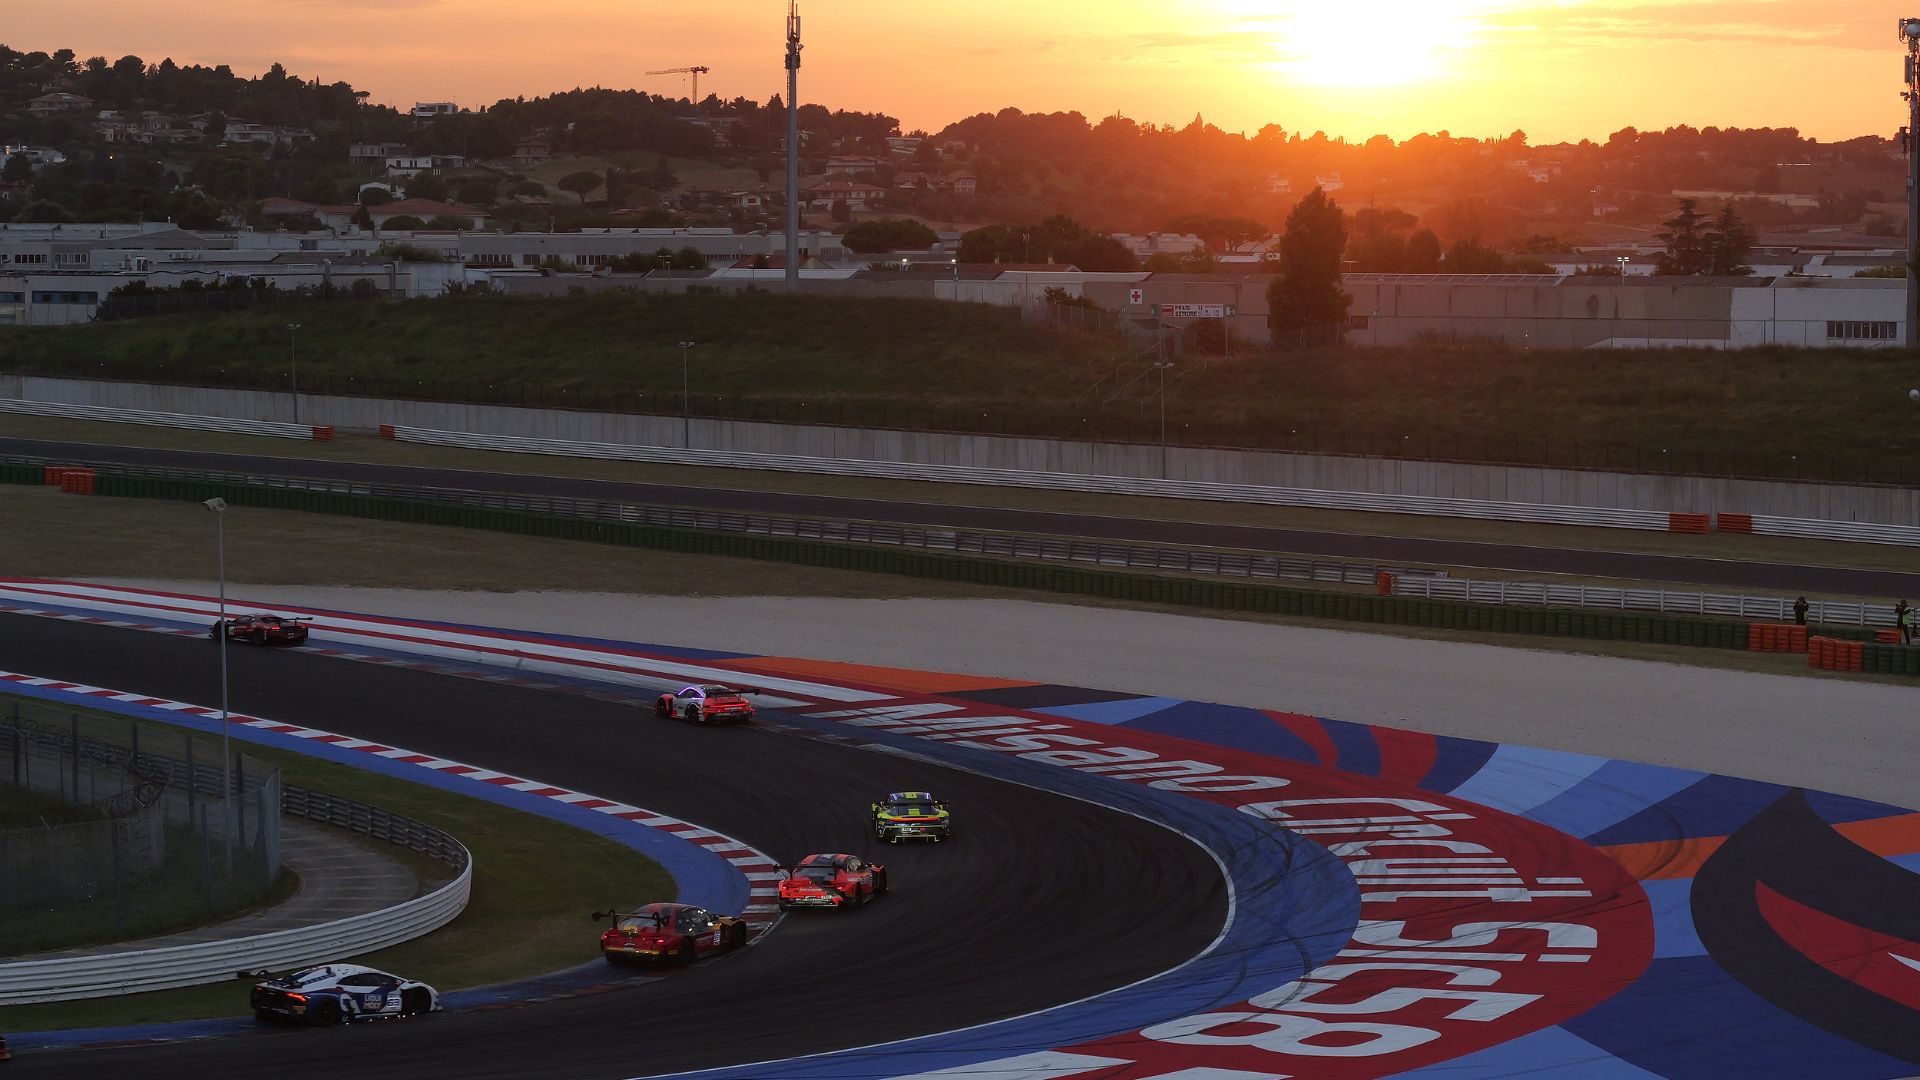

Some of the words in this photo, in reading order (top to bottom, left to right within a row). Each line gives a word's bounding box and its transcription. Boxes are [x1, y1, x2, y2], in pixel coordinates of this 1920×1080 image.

[799, 702, 1291, 792] Misano
[1237, 797, 1592, 902] Circuit
[388, 998, 400, 1006] 63
